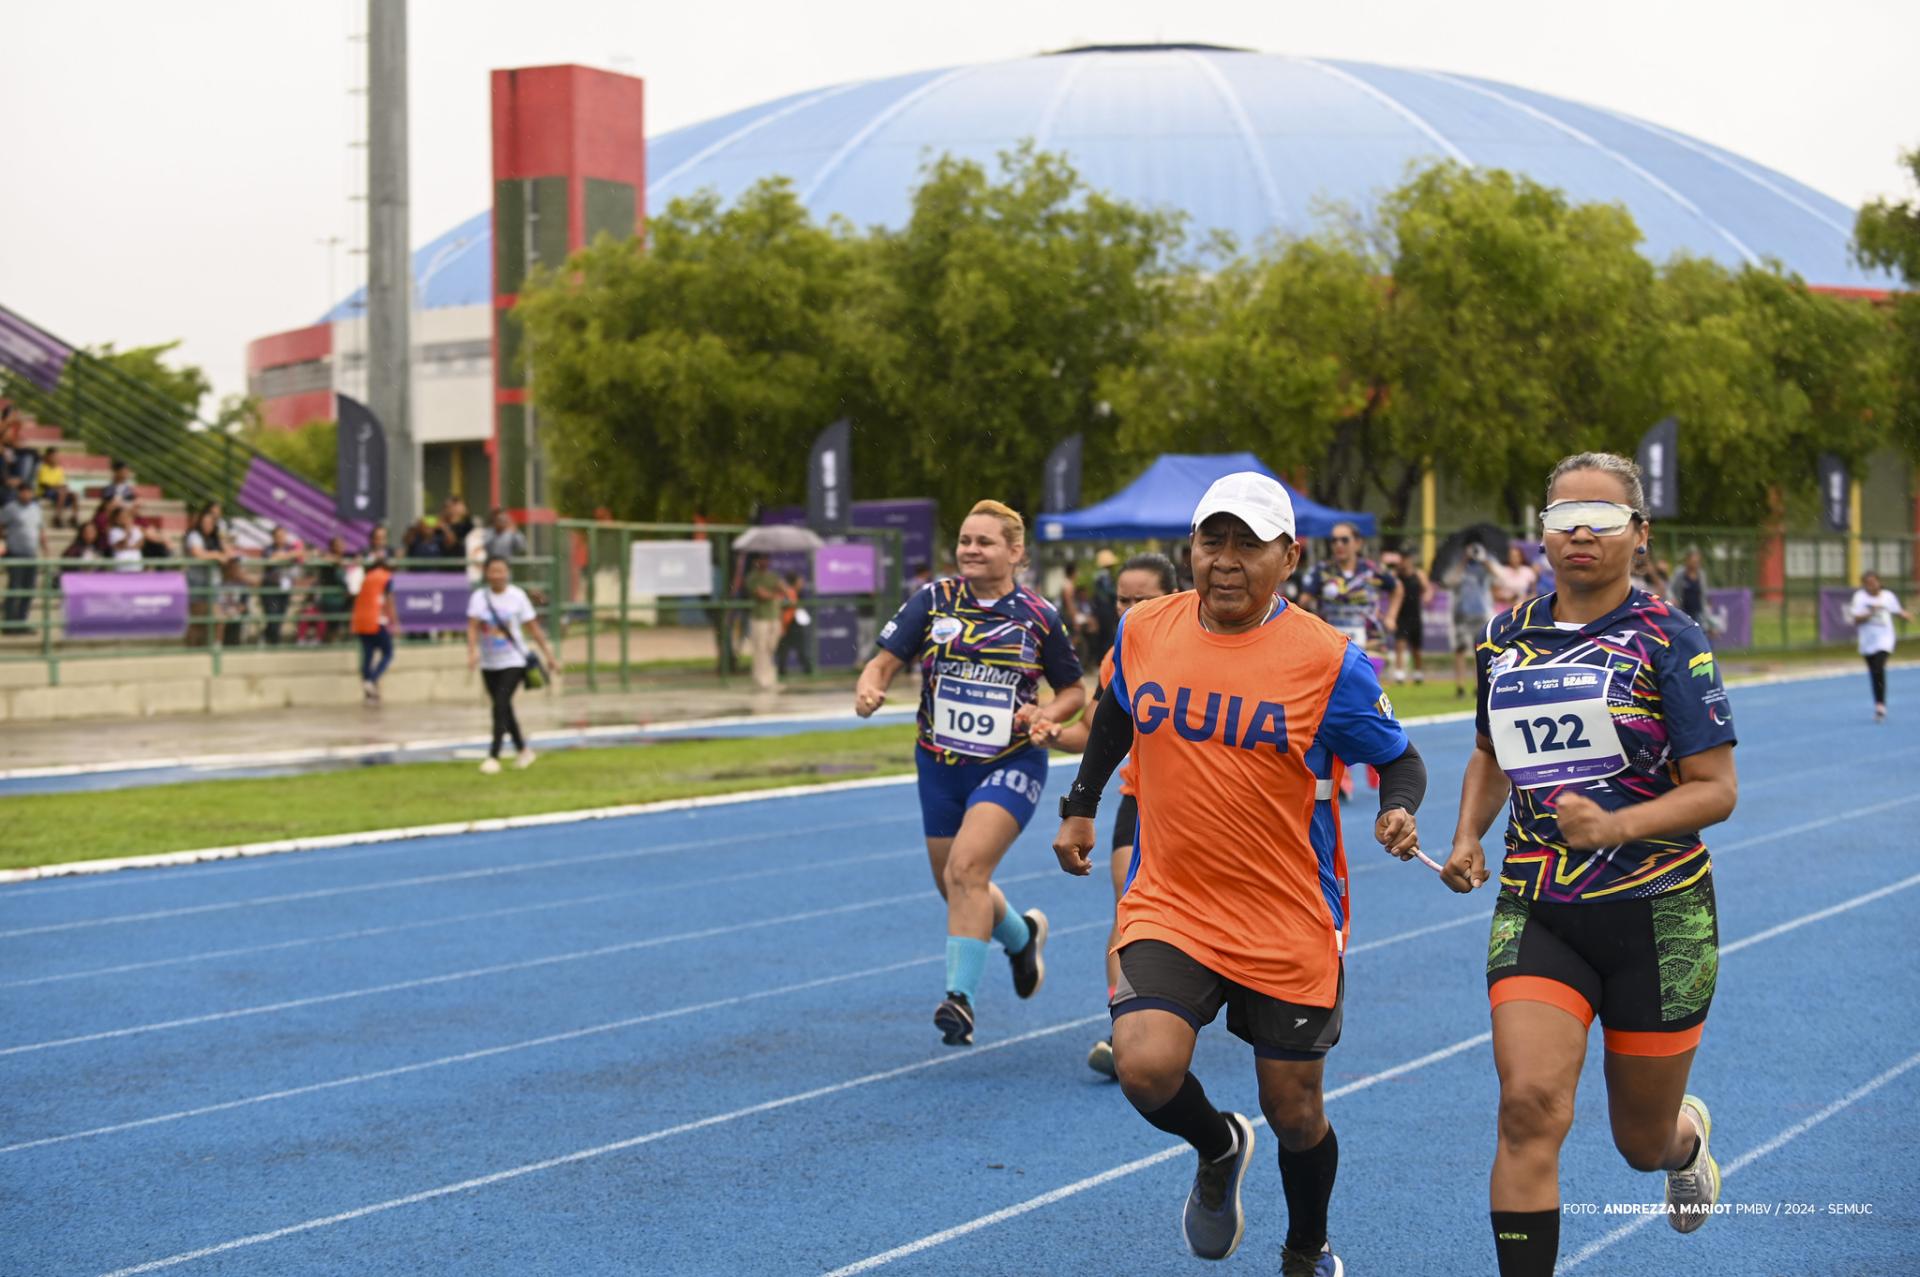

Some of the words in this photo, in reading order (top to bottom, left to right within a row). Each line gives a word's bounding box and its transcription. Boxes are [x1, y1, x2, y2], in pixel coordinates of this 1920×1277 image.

[947, 708, 995, 736] 109
[1132, 681, 1289, 754] GUIA
[1514, 713, 1592, 754] 122
